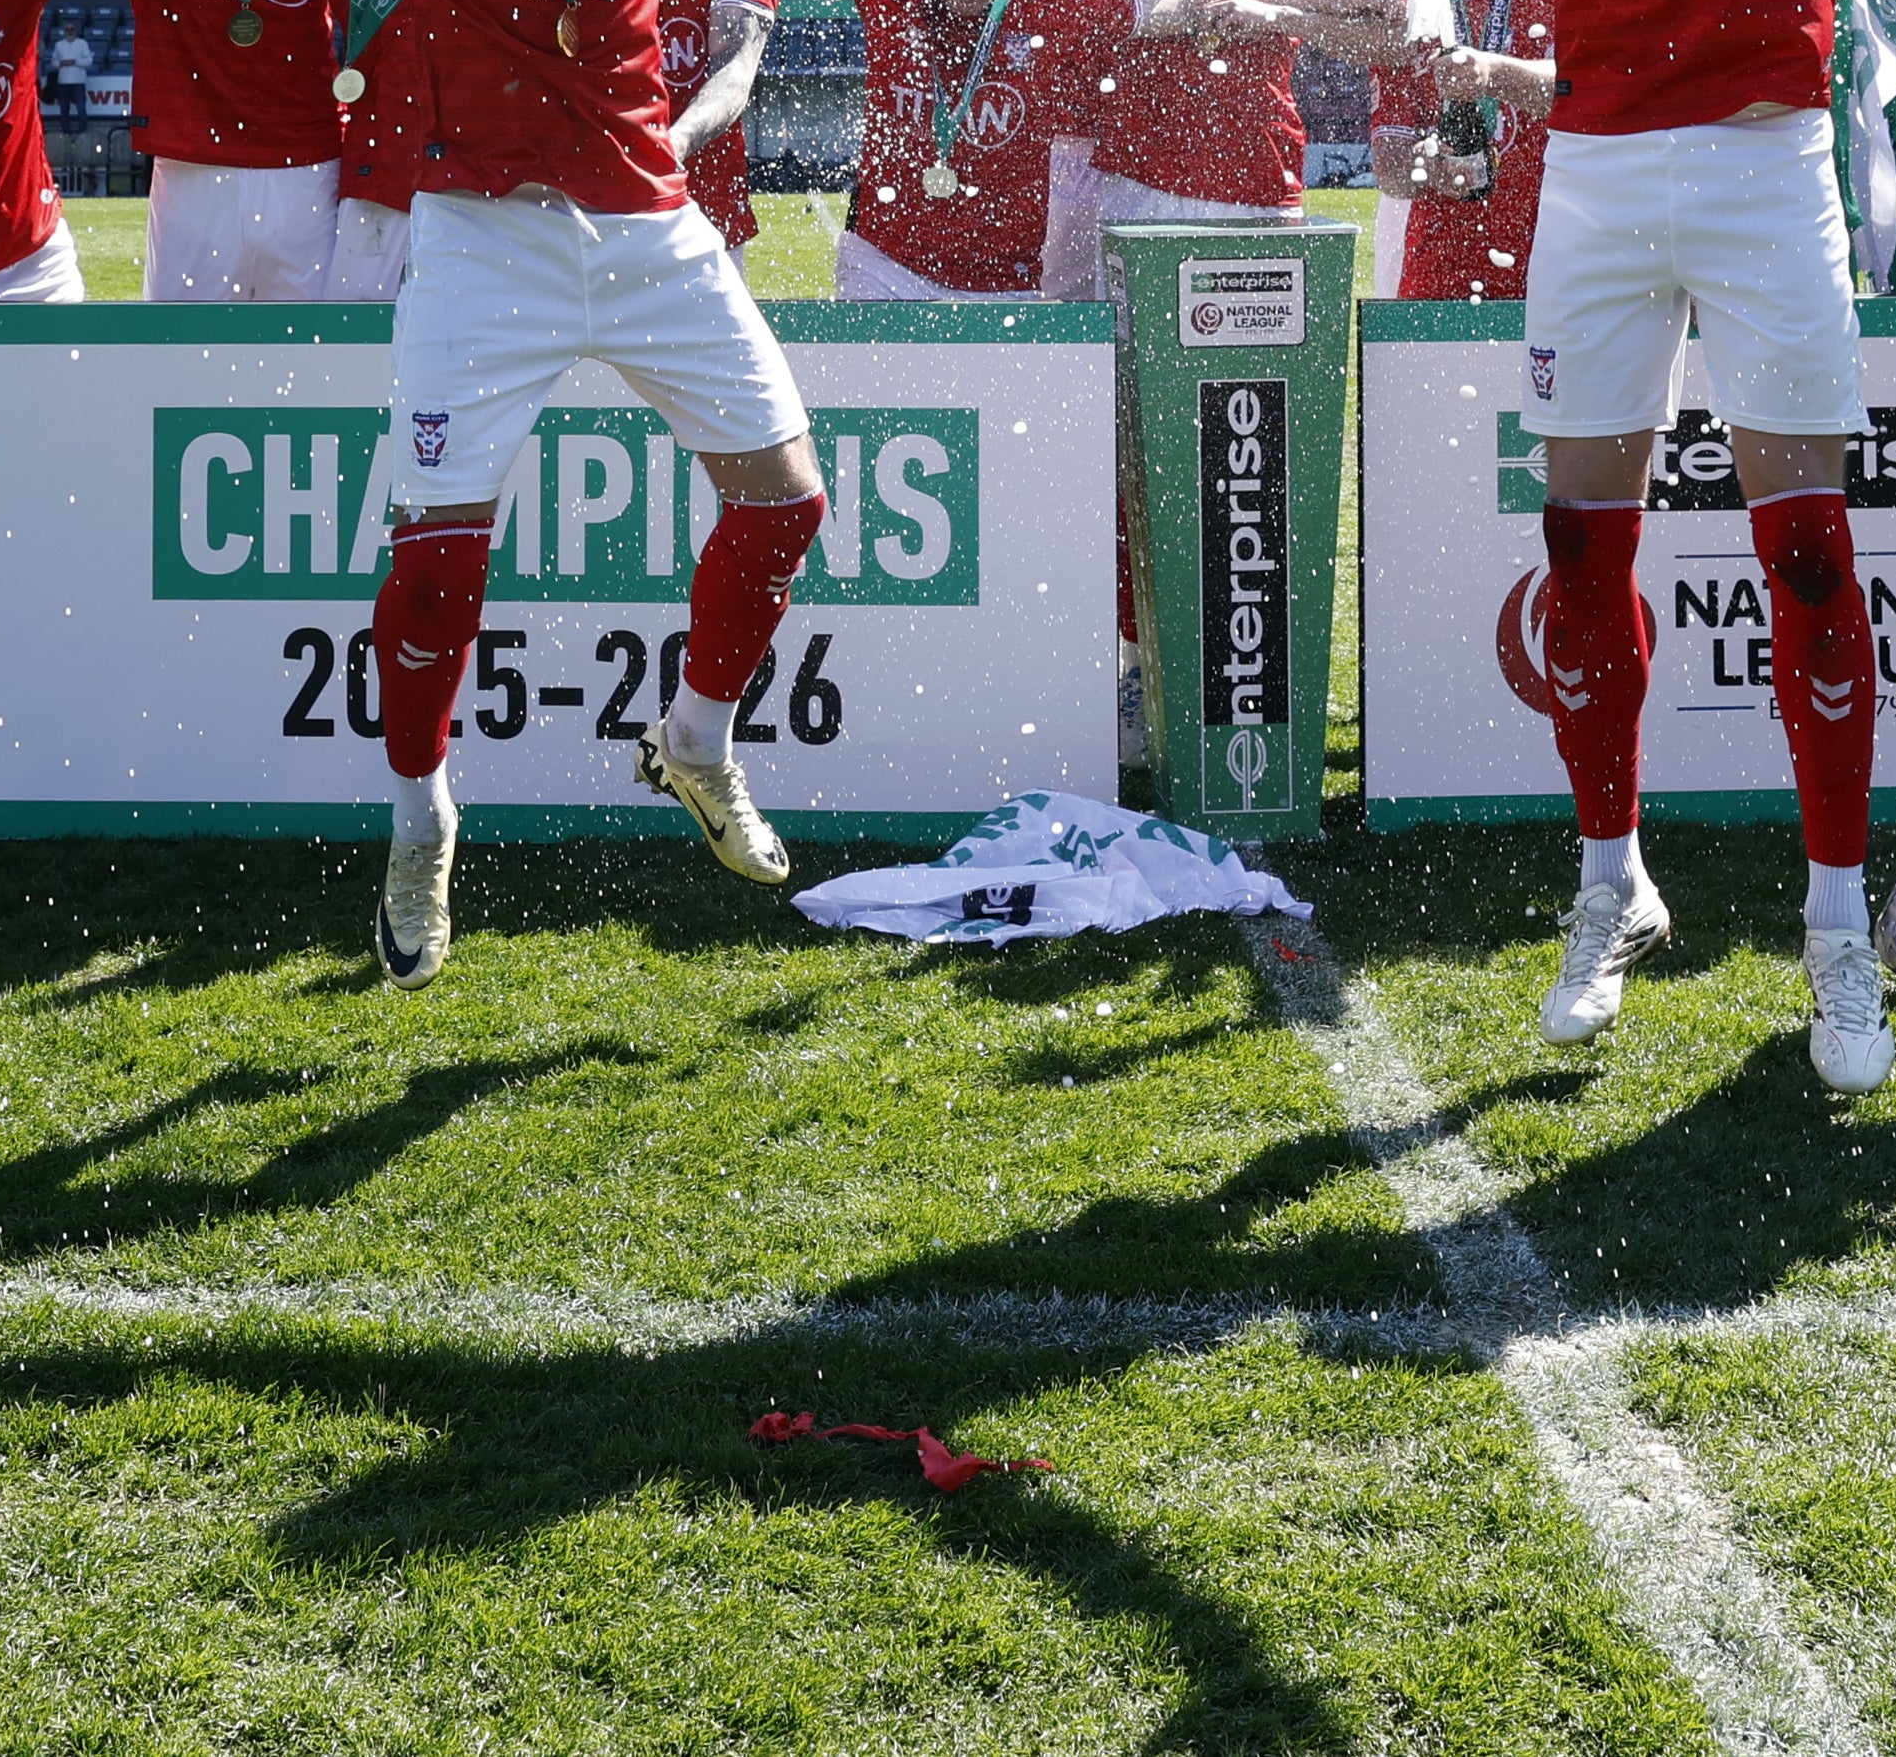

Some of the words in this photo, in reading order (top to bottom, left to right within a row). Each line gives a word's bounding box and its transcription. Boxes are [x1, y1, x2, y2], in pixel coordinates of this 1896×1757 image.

[1196, 274, 1292, 291] enterprise
[1226, 305, 1293, 317] NATIONAL
[1234, 318, 1286, 329] LEAGUE
[1216, 388, 1276, 787] enterprise
